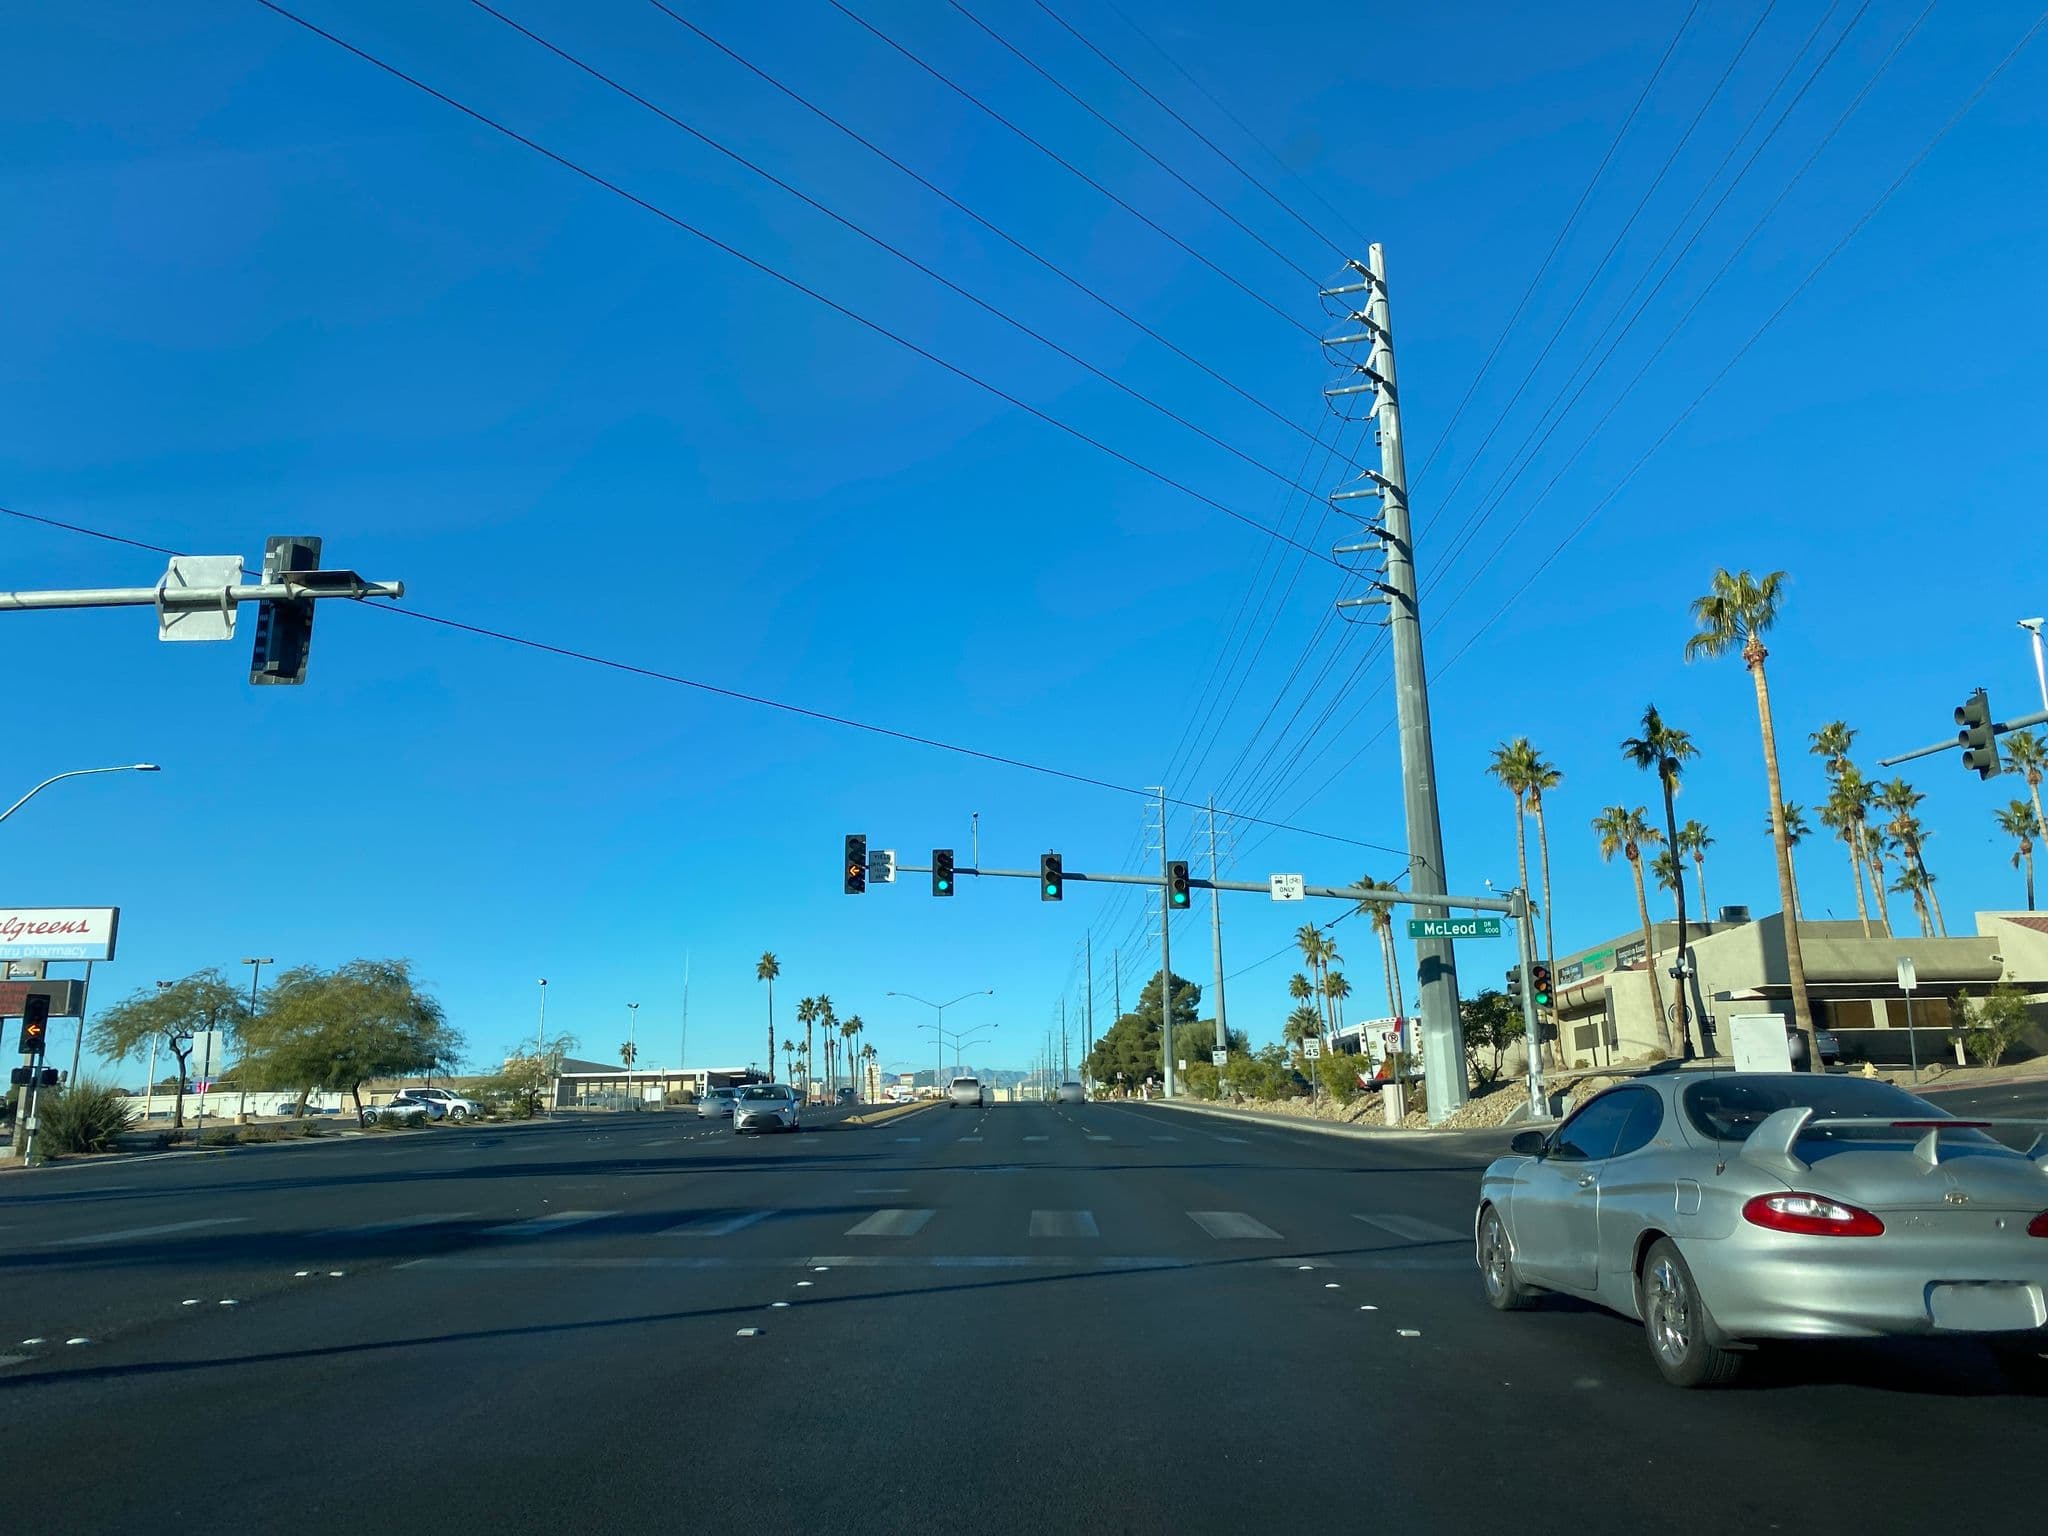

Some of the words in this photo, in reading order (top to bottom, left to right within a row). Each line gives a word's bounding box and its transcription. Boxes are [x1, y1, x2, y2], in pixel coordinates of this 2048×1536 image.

[0, 917, 90, 941] lgreens
[1424, 922, 1476, 935] McLeod
[23, 946, 87, 957] pharmacy
[1306, 1048, 1319, 1057] 45
